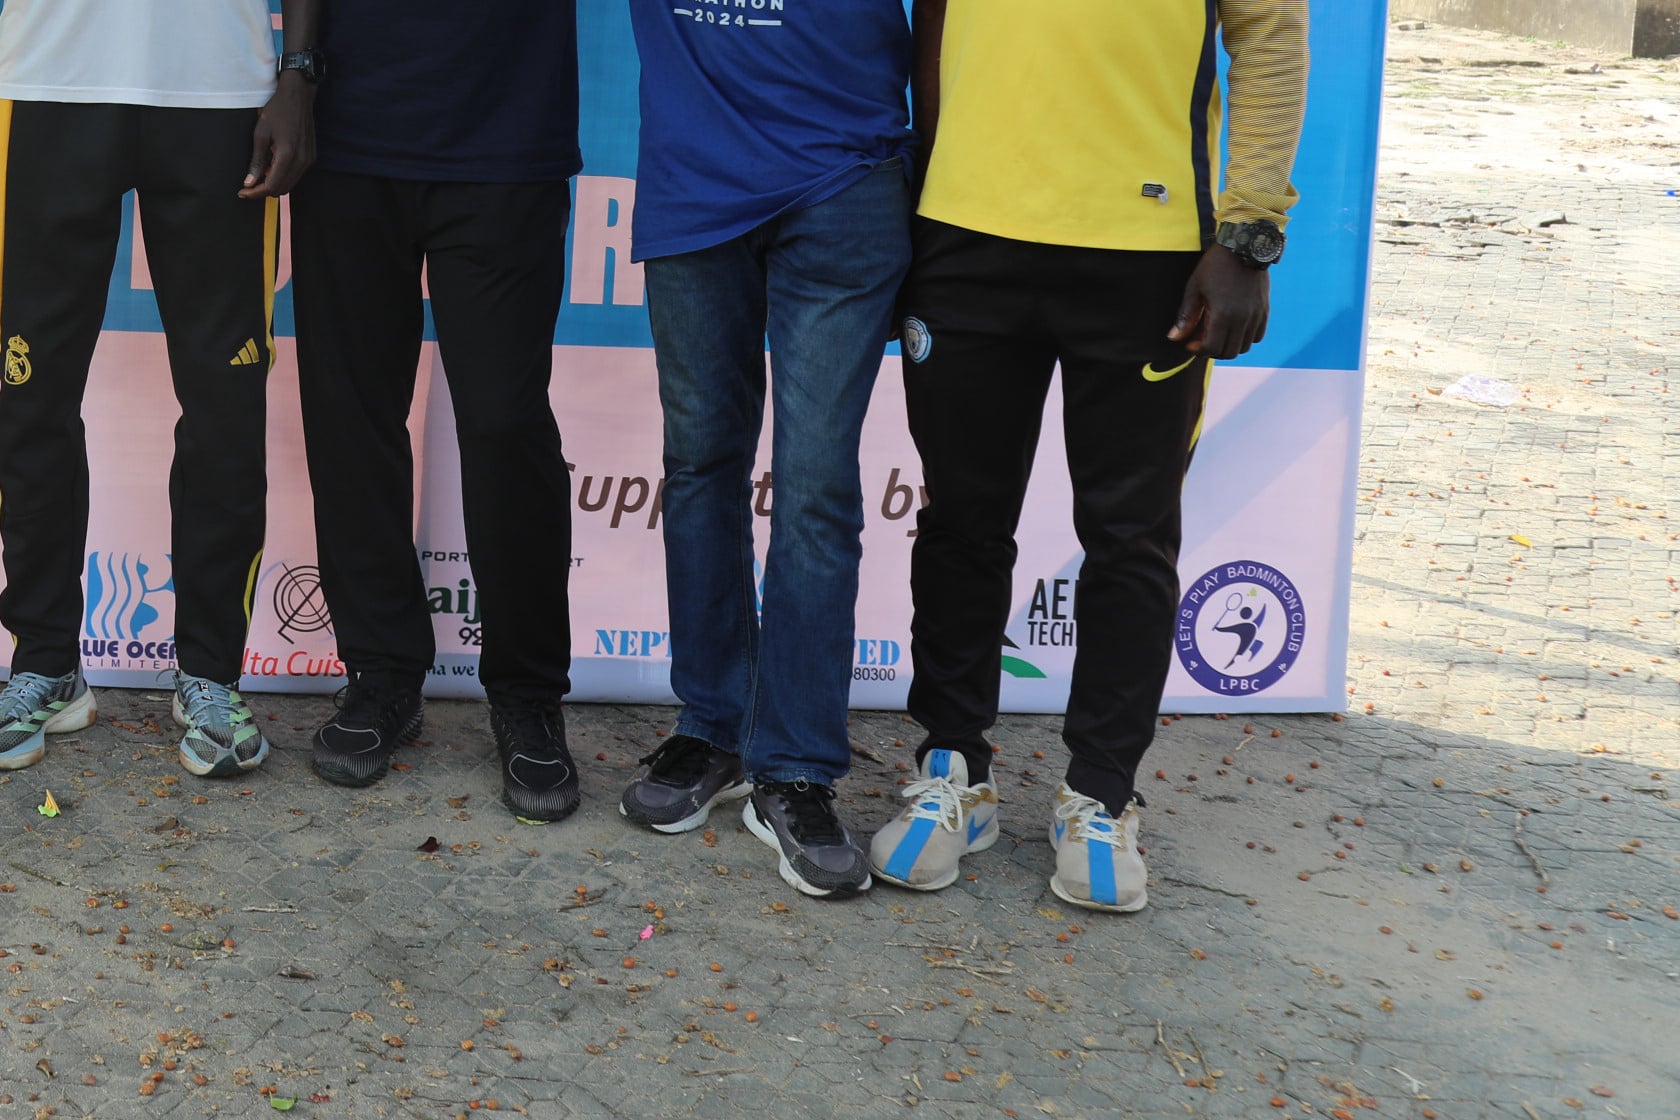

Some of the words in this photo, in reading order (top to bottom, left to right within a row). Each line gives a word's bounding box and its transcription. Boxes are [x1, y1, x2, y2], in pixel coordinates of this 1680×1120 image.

[695, 9, 745, 28] 2024
[428, 578, 482, 624] aij
[1179, 609, 1193, 651] LET'S
[1189, 572, 1219, 604] PLAY
[1227, 565, 1299, 610] BADMINTON
[1288, 612, 1303, 652] CLUB
[80, 639, 119, 657] LUE
[594, 628, 672, 658] NEPT
[86, 657, 177, 671] LIMITED
[242, 647, 277, 676] lta
[286, 651, 345, 677] Cuis
[452, 666, 476, 676] we
[852, 667, 896, 681] 80300
[1219, 678, 1260, 691] LPBC
